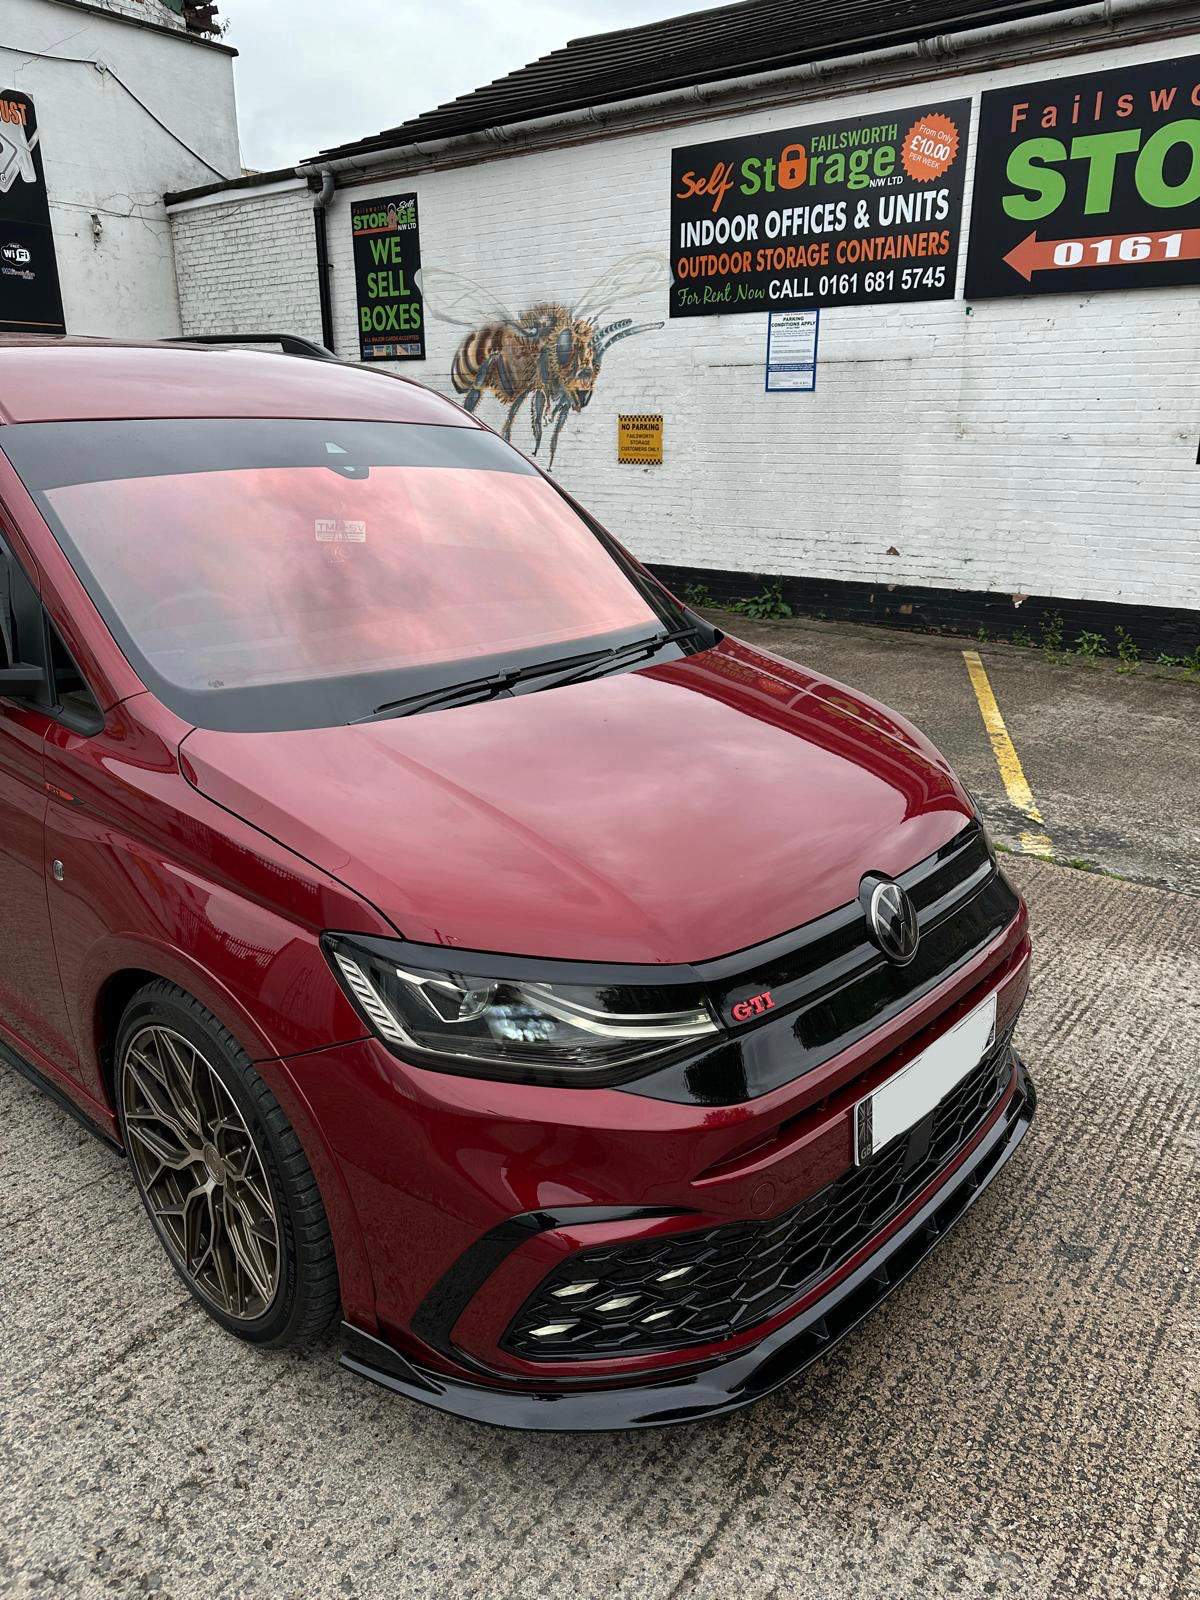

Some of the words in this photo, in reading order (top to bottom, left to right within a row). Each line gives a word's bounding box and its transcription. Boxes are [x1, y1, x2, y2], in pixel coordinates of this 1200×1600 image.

[811, 124, 897, 153] FAILSWORTH
[910, 135, 950, 161] £10.00
[920, 124, 937, 137] From
[938, 131, 953, 144] Only
[909, 152, 922, 162] PER
[922, 157, 941, 169] WEEK
[1002, 118, 1200, 221] STO
[676, 161, 735, 213] Self
[869, 177, 886, 188] N/W
[887, 175, 903, 186] LTD
[408, 222, 417, 230] LTD
[680, 213, 758, 248] INDOOR
[765, 201, 847, 239] OFFICES
[853, 200, 870, 230] &
[878, 188, 950, 227] UNITS
[369, 236, 402, 266] WE
[677, 253, 751, 279] OUTDOOR
[756, 242, 829, 273] STORAGE
[836, 230, 950, 263] CONTAINERS
[1053, 233, 1182, 266] 0161
[367, 270, 411, 299] SELL
[677, 288, 701, 307] For
[703, 285, 732, 305] Rent
[733, 283, 765, 302] Now
[769, 277, 814, 300] CALL
[819, 273, 858, 296] 0161
[864, 269, 895, 292] 681
[901, 266, 945, 290] 5745
[361, 303, 421, 332] BOXES
[731, 991, 776, 1022] GTI
[861, 1143, 872, 1160] GB
